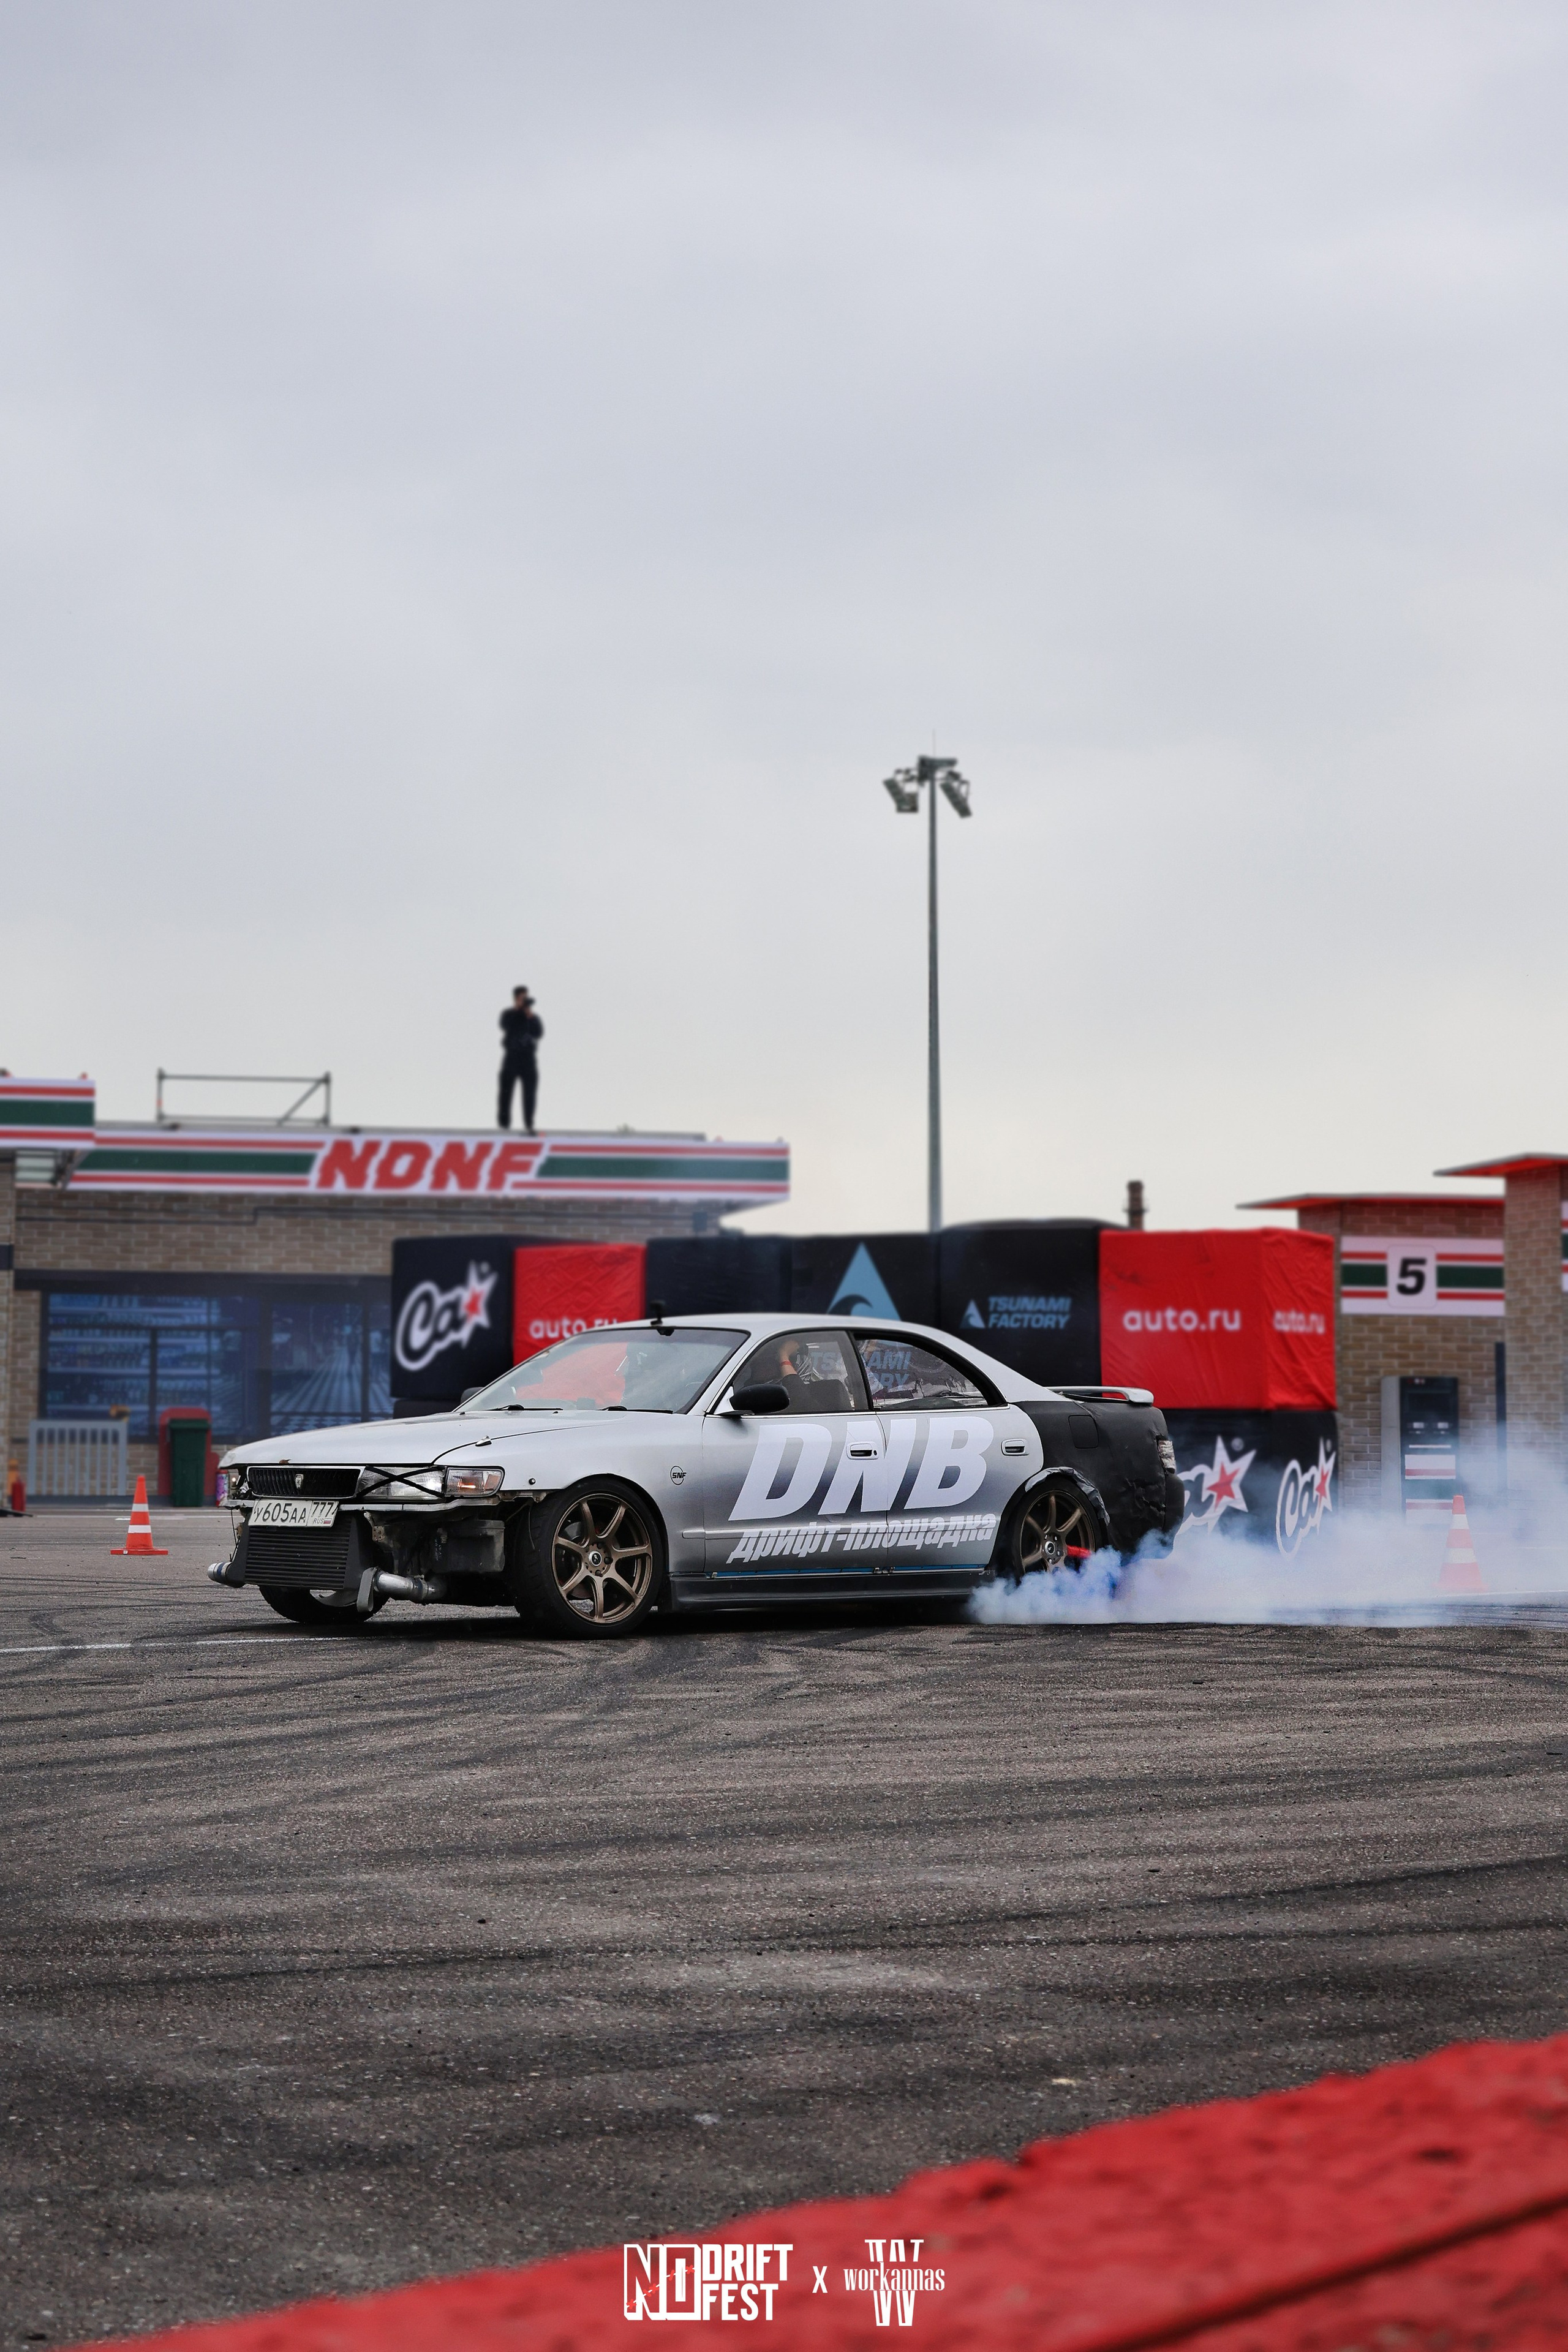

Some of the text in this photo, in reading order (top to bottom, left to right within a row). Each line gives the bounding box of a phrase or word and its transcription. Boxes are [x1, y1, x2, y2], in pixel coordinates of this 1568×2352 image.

[1396, 1257, 1427, 1296] 5
[988, 1296, 1072, 1311] TSUNAMI
[529, 1316, 617, 1338] autor
[988, 1313, 1071, 1329] FACTORY
[1123, 1307, 1240, 1331] auto.ru
[1273, 1310, 1325, 1335] auto.ru
[728, 1415, 995, 1521] DNB
